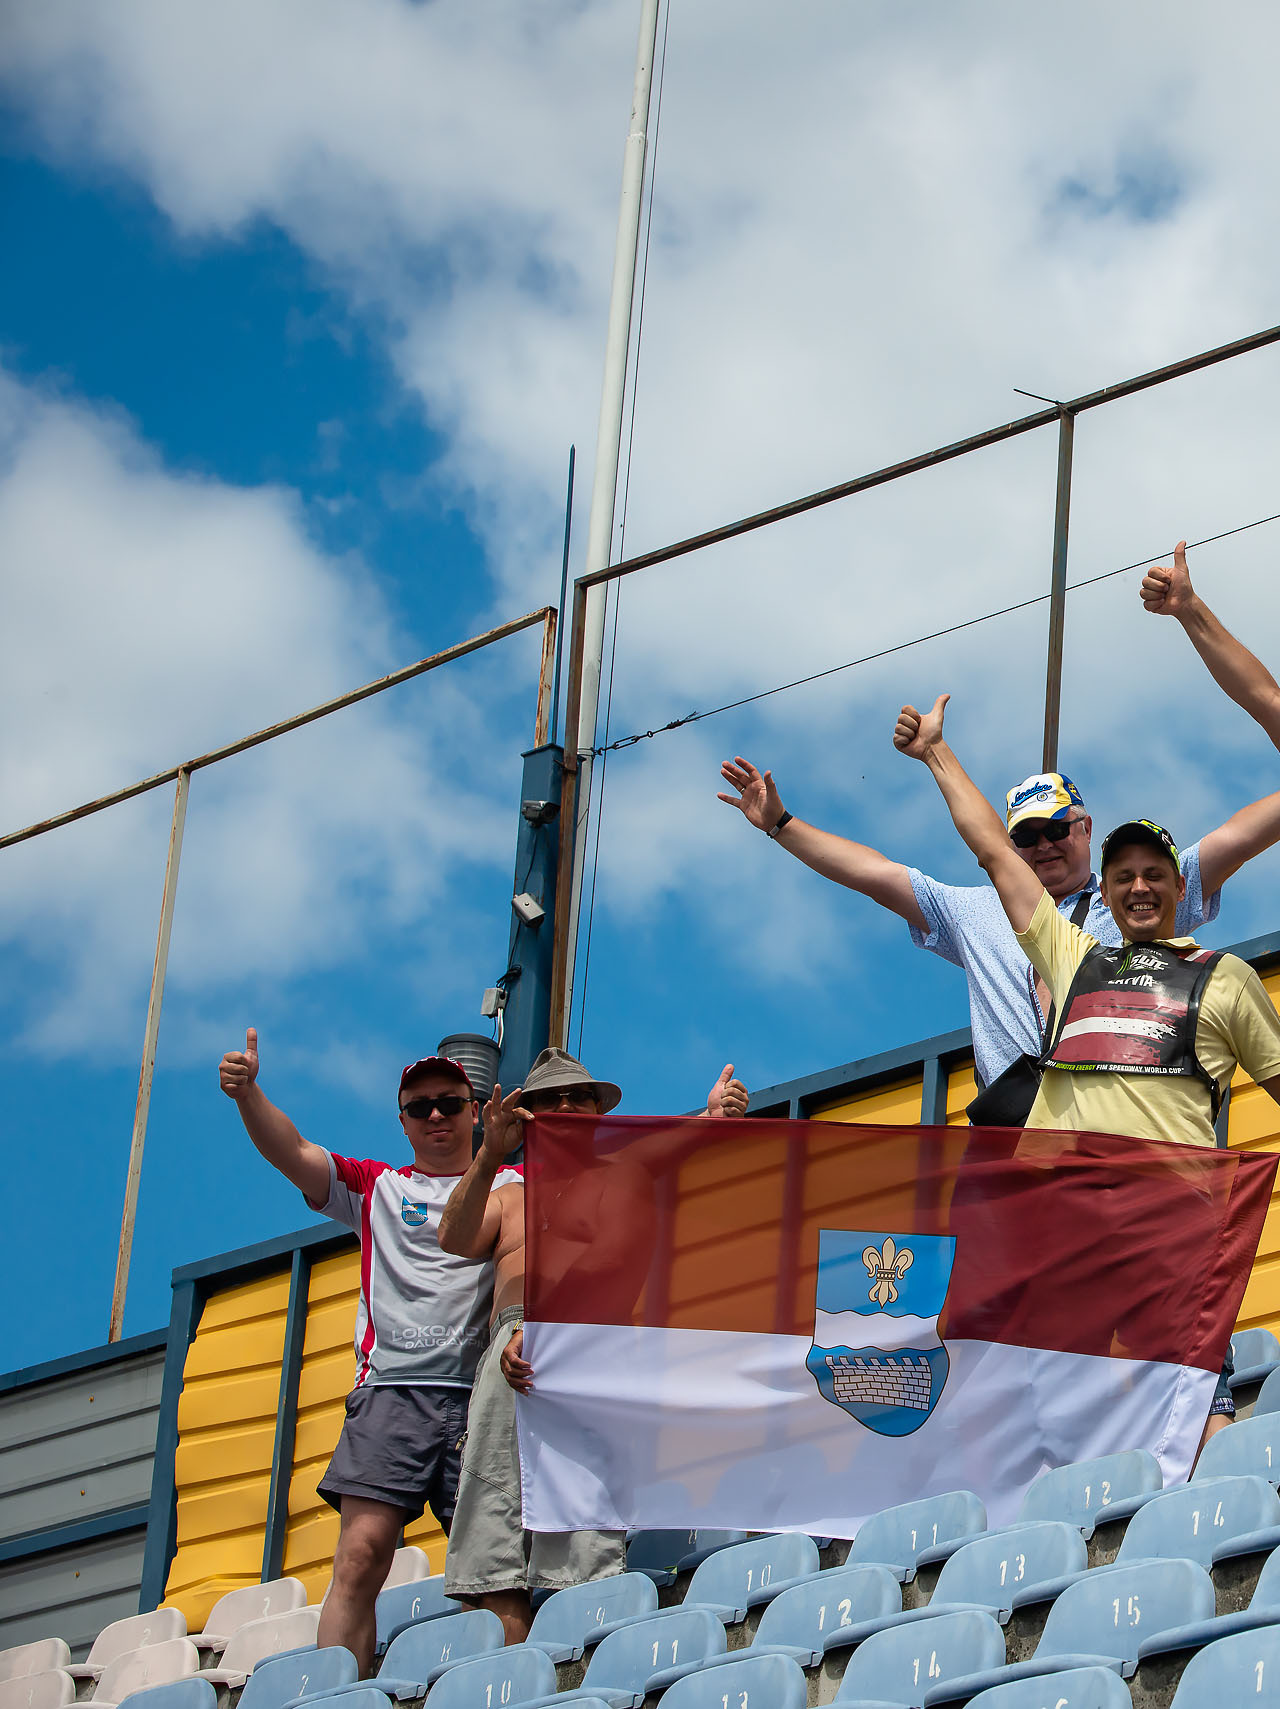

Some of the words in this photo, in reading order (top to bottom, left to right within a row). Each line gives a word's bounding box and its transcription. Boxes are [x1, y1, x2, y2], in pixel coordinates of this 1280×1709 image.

[1108, 1064, 1143, 1073] SPEEDWAY
[1144, 1066, 1167, 1074] WORLD
[392, 1324, 484, 1342] LOKOMO
[1085, 1482, 1111, 1509] 12
[1191, 1502, 1224, 1536] 14
[911, 1523, 939, 1551] 11
[747, 1564, 772, 1592] 10
[1000, 1554, 1025, 1586] 13
[818, 1599, 851, 1631] 12
[1112, 1596, 1141, 1626] 15
[652, 1640, 678, 1666] 11
[913, 1651, 940, 1686] 14
[485, 1680, 511, 1707] 10
